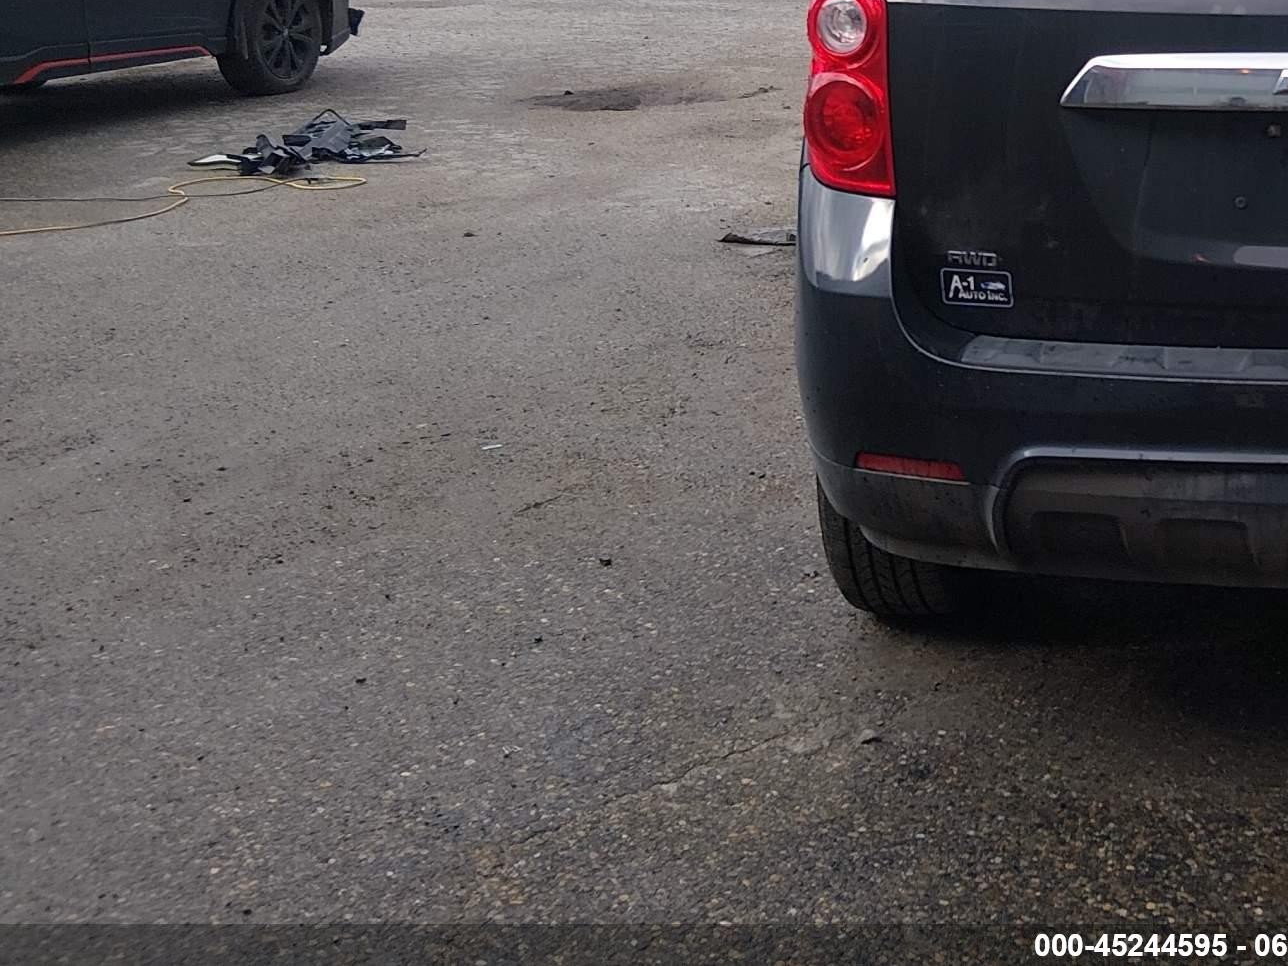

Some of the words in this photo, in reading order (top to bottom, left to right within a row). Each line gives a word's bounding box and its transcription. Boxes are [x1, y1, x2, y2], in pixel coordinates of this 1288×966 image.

[948, 250, 997, 266] AWD
[948, 274, 975, 299] A-1
[958, 290, 986, 300] AUTO
